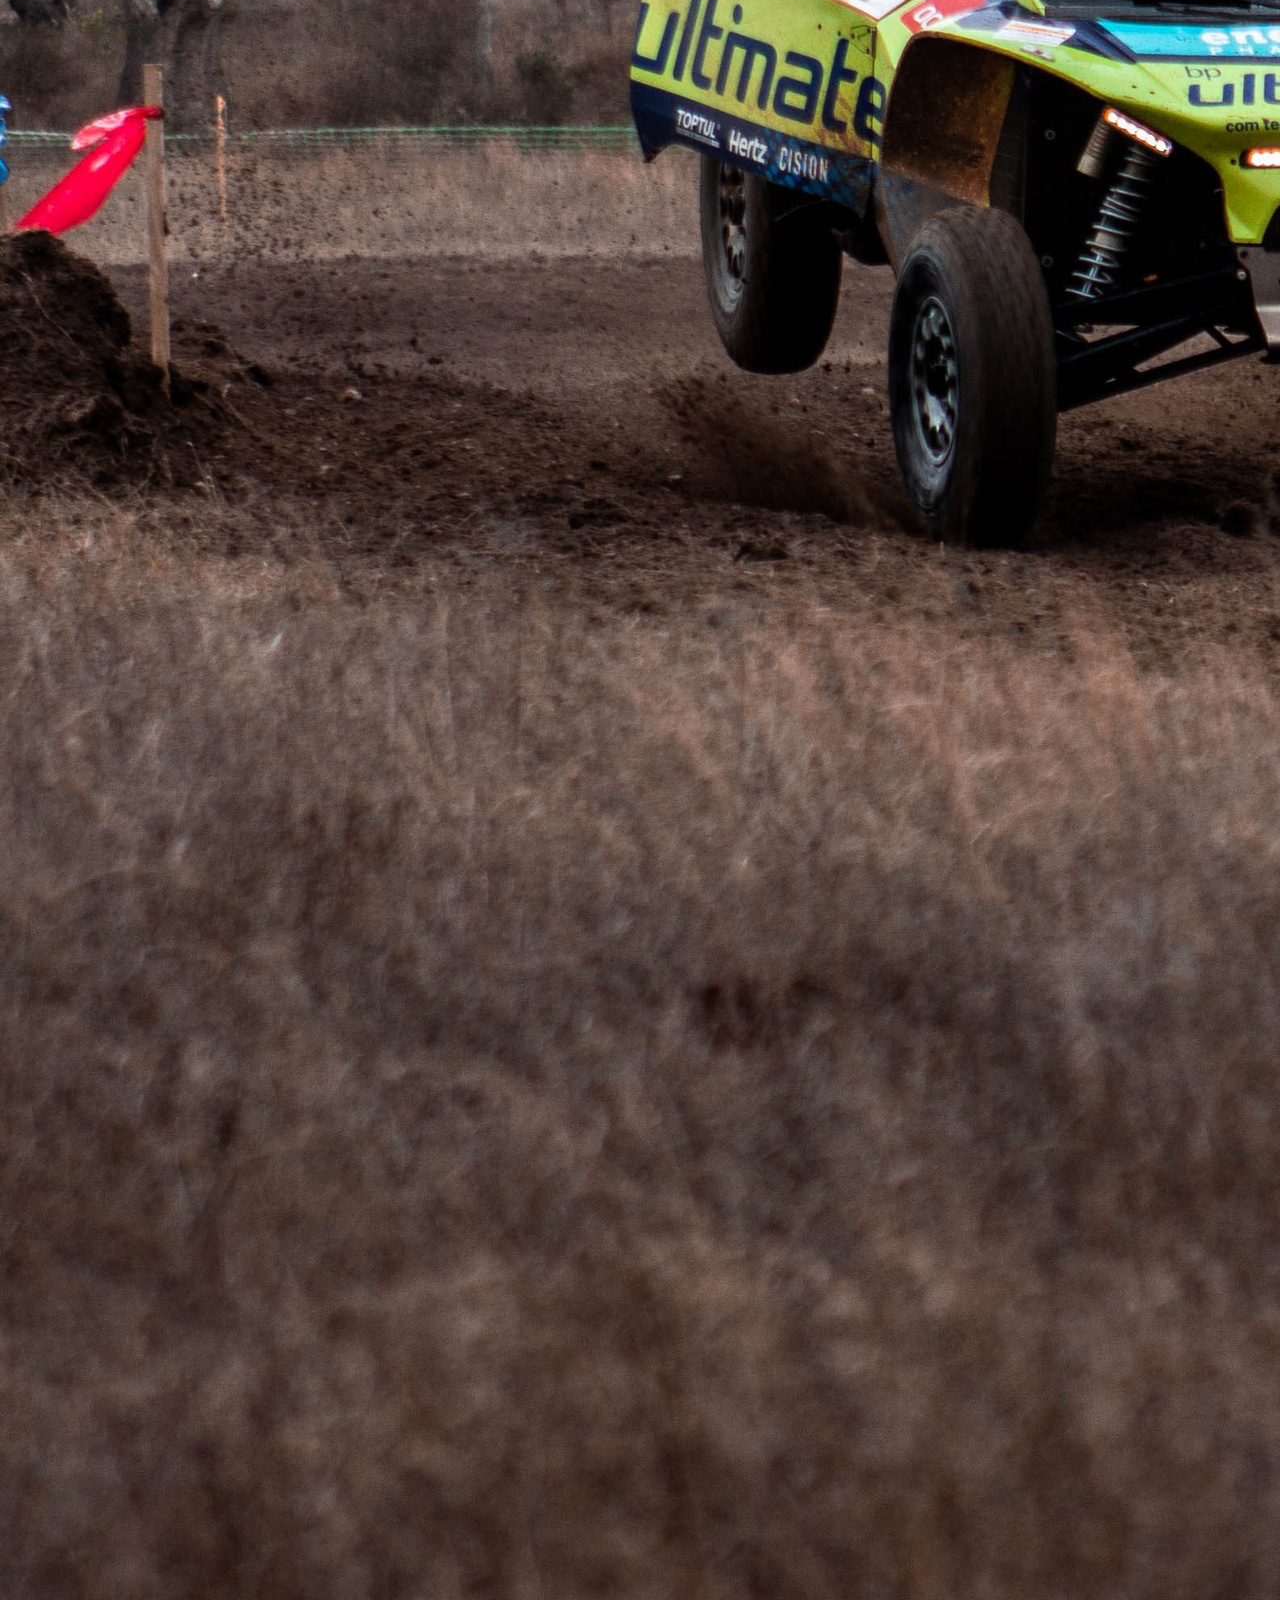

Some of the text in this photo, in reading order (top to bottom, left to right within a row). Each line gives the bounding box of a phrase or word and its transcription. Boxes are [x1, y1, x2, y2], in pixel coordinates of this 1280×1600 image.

[1184, 65, 1222, 81] bp
[676, 108, 717, 139] TOPTUL
[1225, 120, 1259, 132] com
[728, 129, 769, 164] Hertz
[778, 146, 830, 183] CISION
